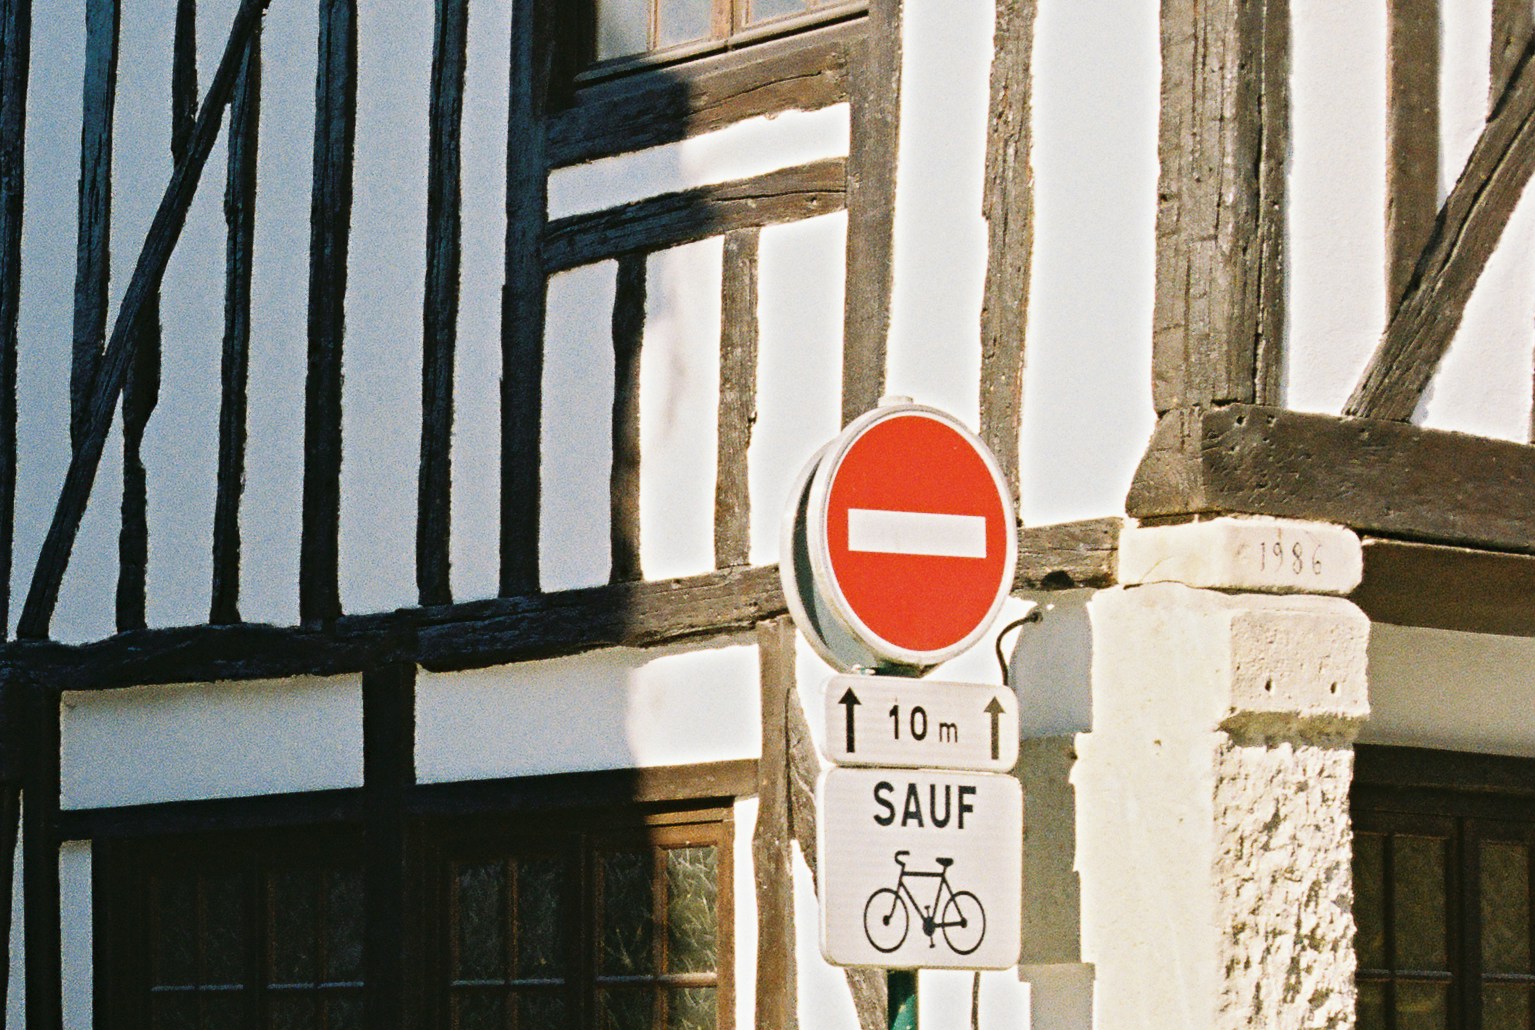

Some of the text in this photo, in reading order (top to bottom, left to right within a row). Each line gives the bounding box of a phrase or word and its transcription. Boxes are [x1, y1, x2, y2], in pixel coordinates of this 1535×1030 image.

[888, 705, 958, 743] 10 m
[873, 781, 976, 829] SAUF
